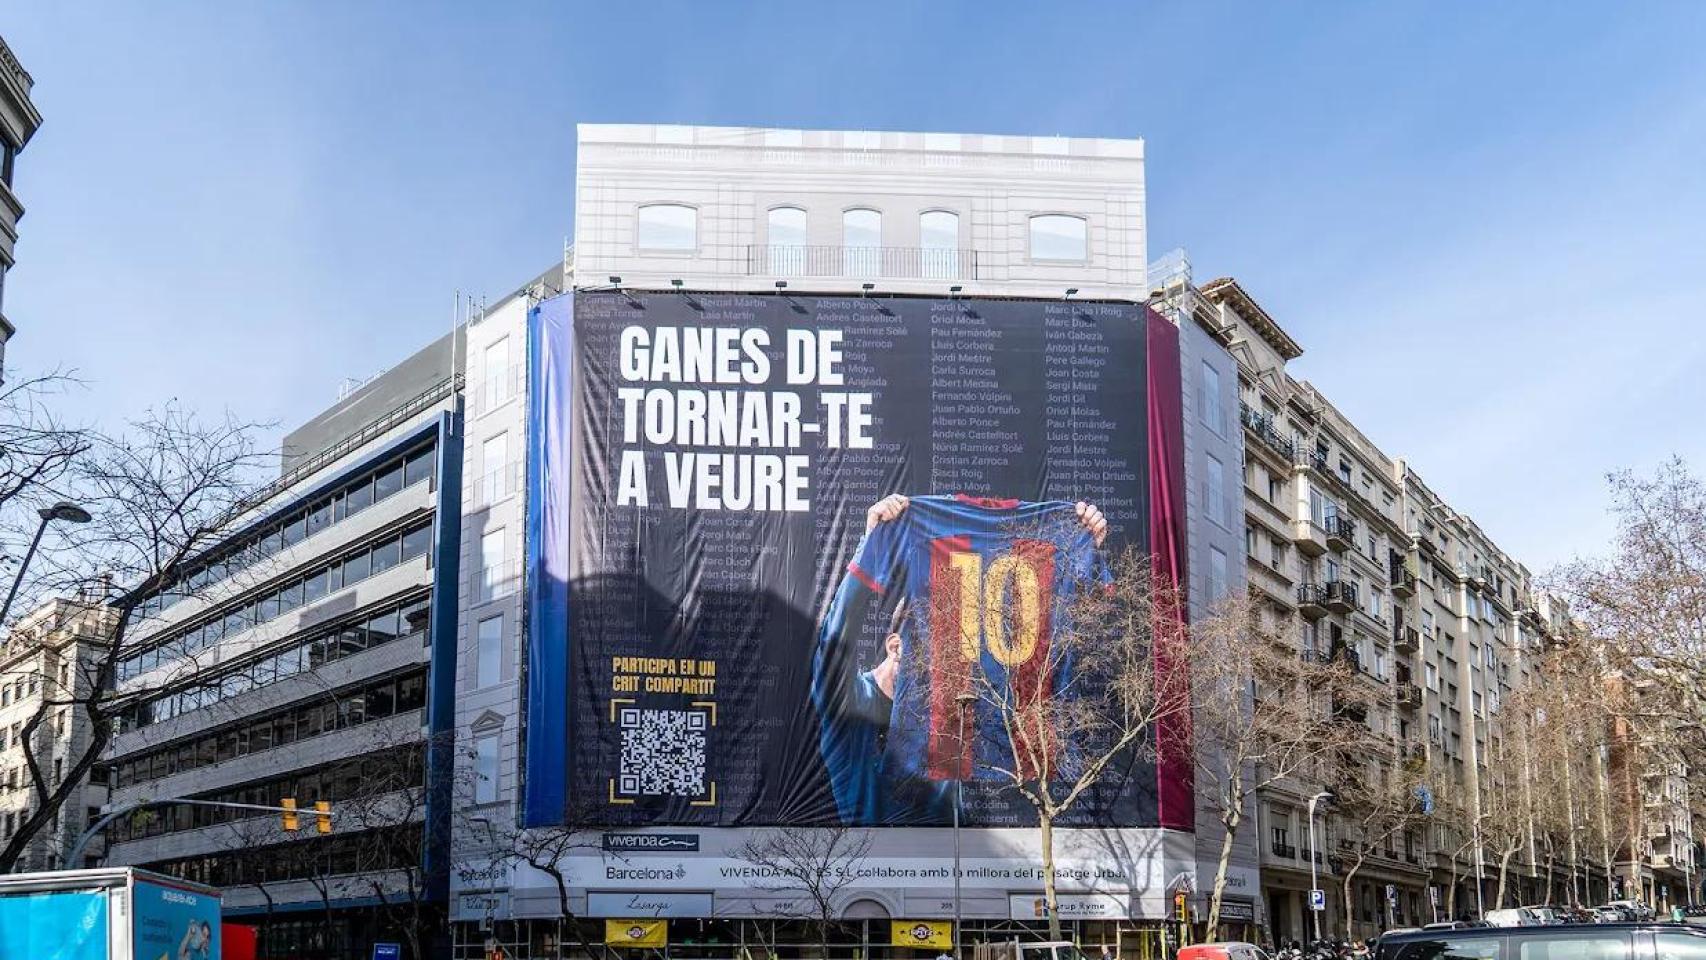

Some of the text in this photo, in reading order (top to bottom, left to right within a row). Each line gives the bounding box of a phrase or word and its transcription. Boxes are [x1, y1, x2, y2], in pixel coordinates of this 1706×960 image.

[816, 300, 850, 309] Alberto
[1045, 317, 1070, 327] Marc
[931, 328, 1003, 338] Pau Fernández
[1067, 331, 1103, 341] Cabeza
[856, 339, 893, 348] Zarroca
[956, 341, 995, 351] Corbera
[620, 326, 844, 385] GANES DE
[931, 353, 992, 363] Jordi Mestre
[1045, 356, 1106, 367] Pere Gallego
[848, 364, 875, 374] Moya
[931, 365, 996, 376] Carla Surroca
[1046, 368, 1100, 378] Joan Costa
[931, 378, 999, 388] Albert Medina
[1046, 381, 1070, 392] Sergi
[932, 391, 977, 401] Fernando
[1046, 394, 1070, 403] Jordi
[932, 404, 1021, 415] Juan Pablo Ortuño
[1046, 406, 1069, 415] Oriol
[618, 388, 873, 449] TORNAR-TE
[932, 417, 1000, 427] Alberto Ponce
[1047, 420, 1065, 429] Pau
[1072, 433, 1109, 442] Corbera
[1047, 445, 1071, 454] Jordi
[842, 454, 871, 463] Pablo
[932, 455, 1009, 466] Cristian Zarroca
[1047, 458, 1092, 467] Fernando
[854, 467, 885, 477] Ponce
[961, 469, 983, 480] Roig
[1074, 471, 1100, 480] Pablo
[616, 451, 810, 511] A VEURE
[964, 482, 991, 493] Moya
[948, 551, 1041, 667] 10
[613, 657, 676, 674] PARTICIPA
[680, 659, 695, 675] EN
[699, 660, 716, 677] UN
[613, 676, 639, 691] CRIT
[645, 677, 716, 695] COMPARTIT
[606, 867, 673, 880] Barcelona
[920, 867, 949, 878] amb
[967, 867, 1010, 878] millora
[1014, 868, 1033, 878] del
[1037, 868, 1090, 880] psatge
[1312, 893, 1321, 904] P
